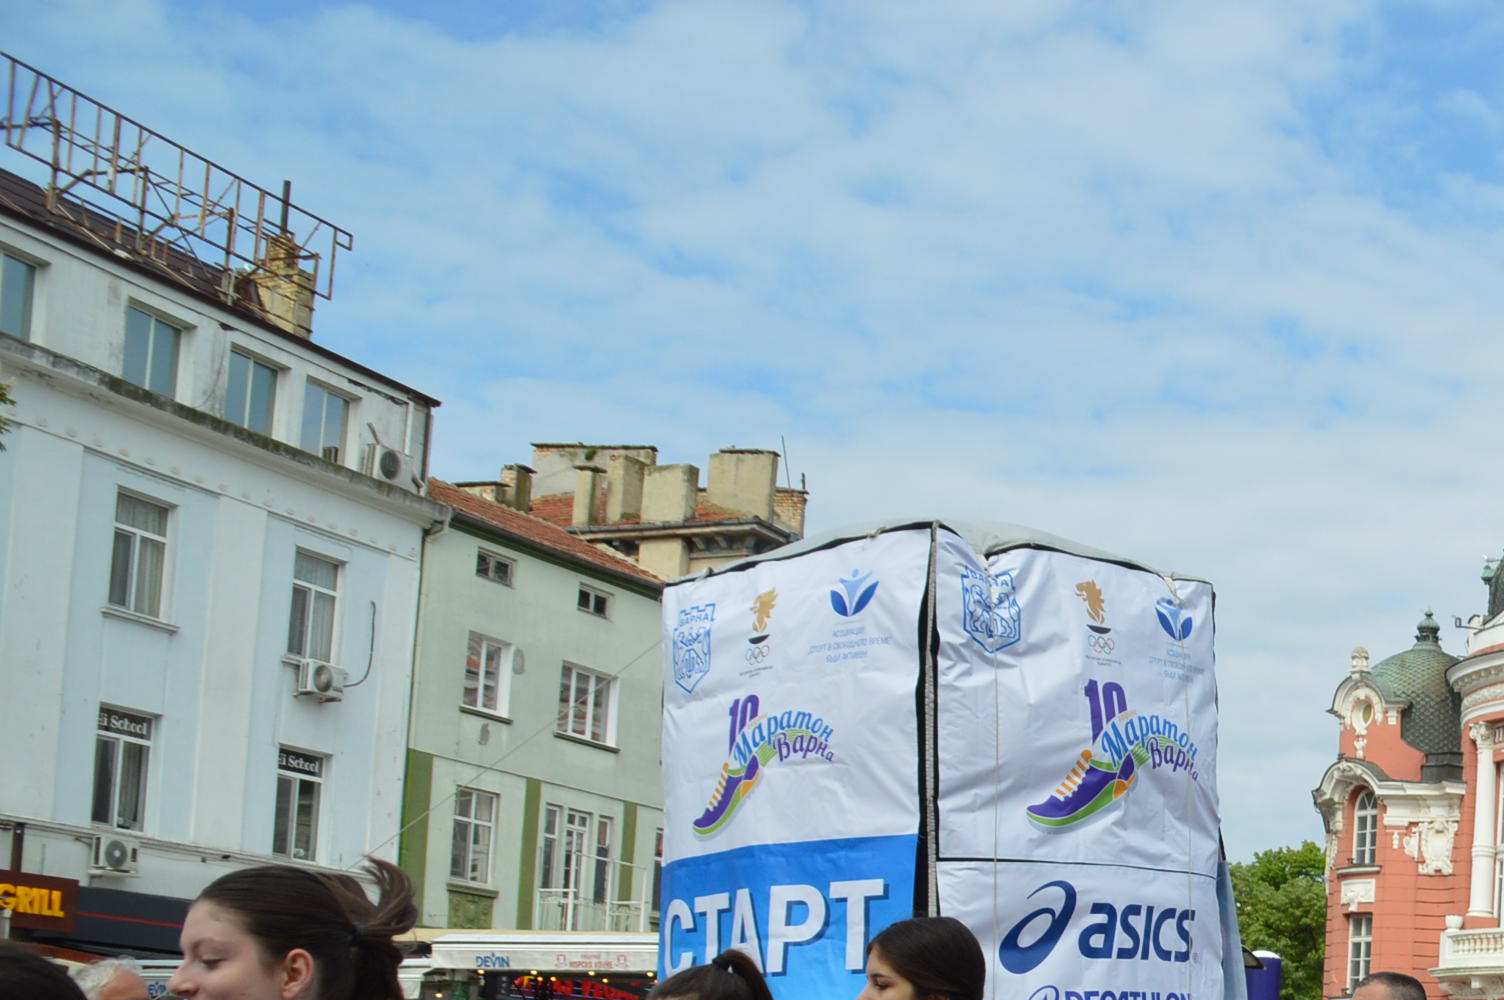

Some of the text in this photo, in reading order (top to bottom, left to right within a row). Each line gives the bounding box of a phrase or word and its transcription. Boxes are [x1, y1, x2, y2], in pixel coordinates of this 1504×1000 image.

[110, 715, 148, 735] School
[728, 694, 760, 757] 10
[1084, 679, 1128, 746] 10
[733, 710, 834, 766] Маратон
[773, 732, 834, 763] Варна
[1101, 714, 1198, 769] Маратон
[1146, 736, 1199, 781] Варна
[288, 755, 320, 773] School
[0, 883, 65, 918] GRILL
[664, 878, 888, 978] СТАРТ
[476, 952, 510, 968] DEVIN
